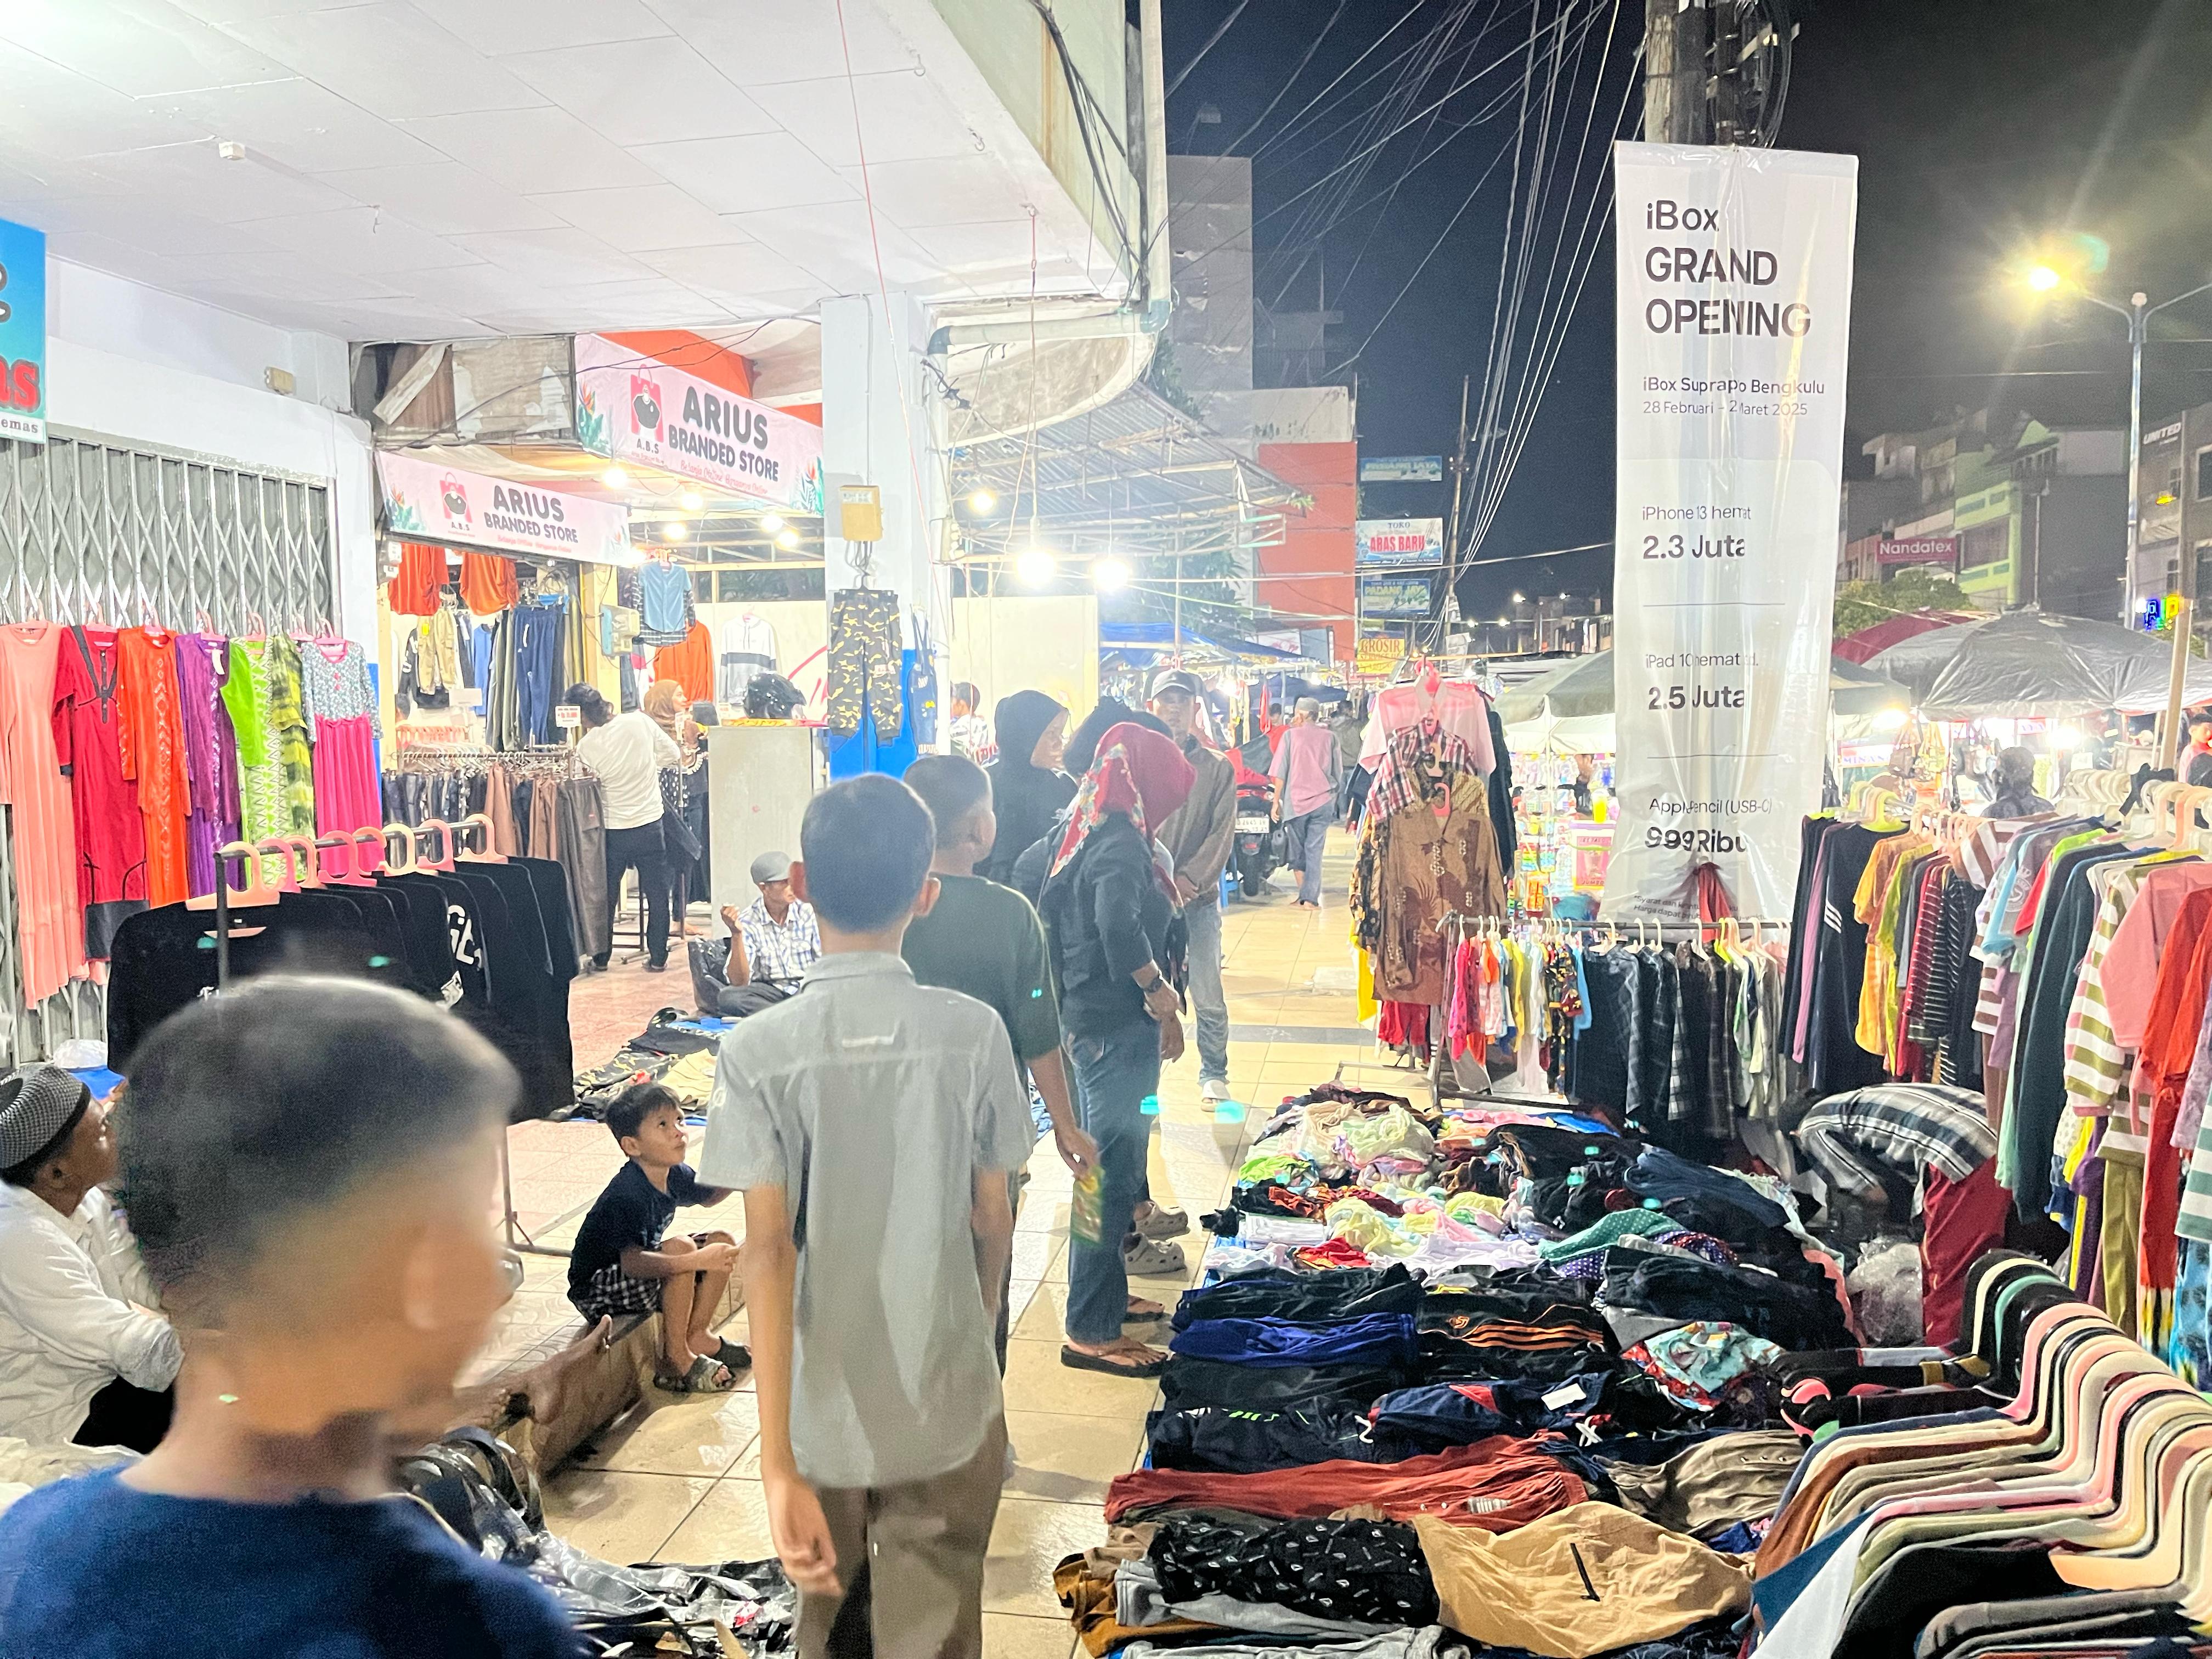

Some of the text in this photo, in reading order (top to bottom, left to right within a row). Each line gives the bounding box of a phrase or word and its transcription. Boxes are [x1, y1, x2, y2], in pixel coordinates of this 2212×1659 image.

[1646, 200, 1719, 231] iBox
[1645, 247, 1777, 285] GRAND
[1645, 299, 1811, 337] OPENING
[1644, 377, 1677, 391] iBox
[1751, 380, 1824, 397] Bengkulu
[683, 386, 768, 450] ARIUS
[1644, 402, 1660, 413] 28
[1664, 402, 1713, 414] Februari
[1729, 400, 1737, 412] 2
[1773, 403, 1807, 415] 2025
[636, 438, 659, 454] A.B.S
[668, 424, 778, 482] BRANDED STORE
[493, 484, 565, 522] ARIUS
[1643, 506, 1694, 520] iPhone
[1696, 506, 1707, 520] 13
[483, 512, 541, 537] BRANDED
[544, 524, 579, 544] STORE
[1643, 534, 1745, 559] 2.3 Juta
[1361, 639, 1400, 652] GROSIR
[1645, 654, 1674, 668] iPad
[1649, 685, 1744, 710] 2.5 Juta
